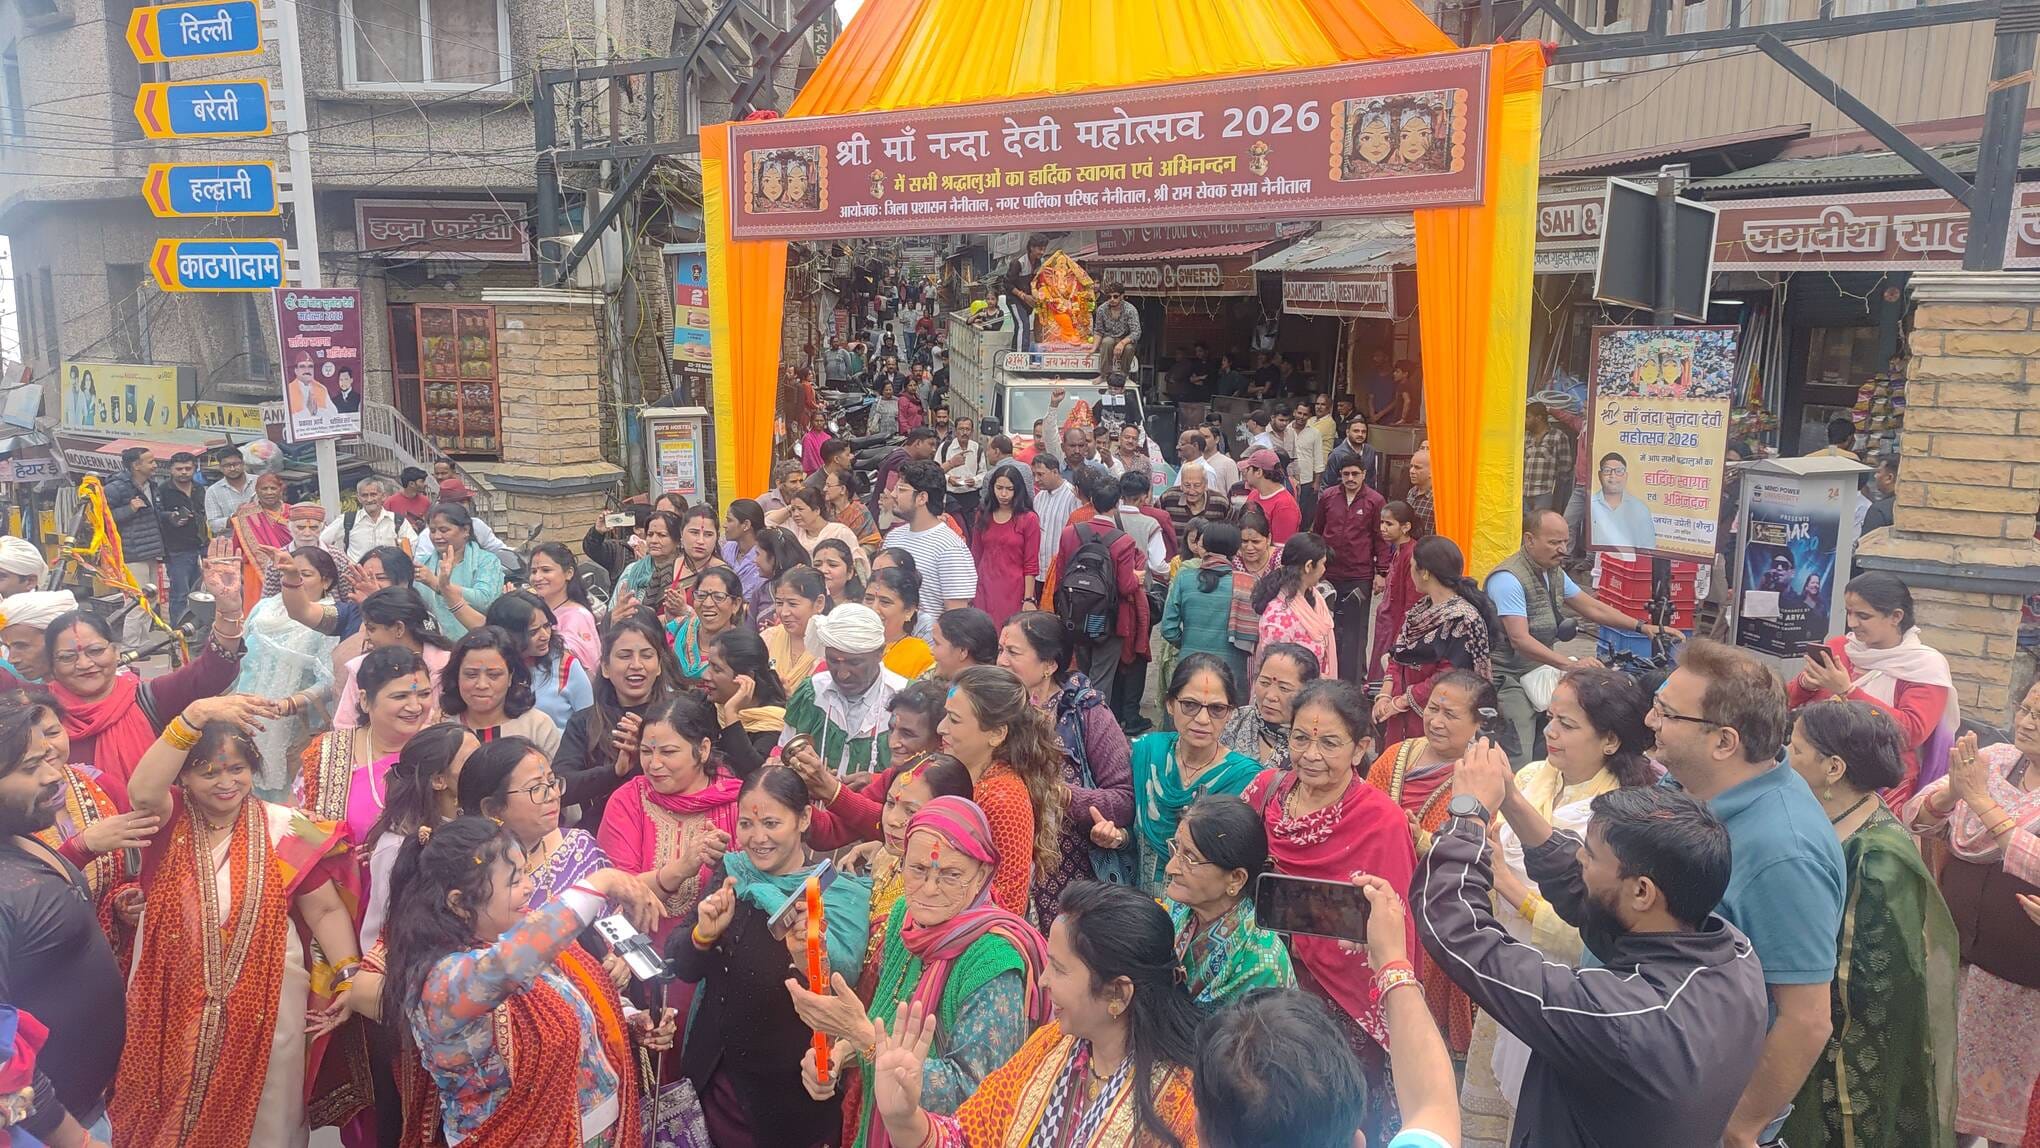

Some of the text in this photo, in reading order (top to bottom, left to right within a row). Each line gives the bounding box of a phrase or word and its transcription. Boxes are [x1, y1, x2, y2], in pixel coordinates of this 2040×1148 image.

[180, 8, 233, 45] दिल्ली
[192, 89, 239, 122] बरेली
[835, 100, 1320, 166] श्री माँ नन्दा देवी महोत्सव 2026
[189, 168, 252, 202] हल्द्वानी
[893, 173, 905, 193] में
[908, 171, 938, 192] सभी
[1005, 170, 1024, 186] का
[1028, 163, 1072, 185] हार्दिक
[1076, 163, 1127, 182] स्वागत
[1131, 156, 1153, 179] एवं
[1158, 153, 1237, 176] अभिनन्दन
[885, 200, 908, 216] जिला
[911, 200, 947, 215] प्रशासन
[950, 195, 993, 213] नैनीताल,
[996, 197, 1020, 211] नगर
[1022, 192, 1061, 209] पालिका
[1102, 186, 1150, 205] नैनीताल,
[1154, 183, 1169, 202] श्री
[1172, 186, 1192, 200] राम
[1196, 181, 1227, 199] सेवक
[1231, 182, 1257, 197] सभा
[1262, 176, 1311, 195] नैनीताल
[368, 218, 426, 241] इन्द्रा
[1541, 205, 1599, 235] SAH &
[1744, 206, 1885, 252] जगदीश
[179, 246, 279, 281] काठगोदाम
[1135, 270, 1158, 286] FOOD
[1178, 268, 1218, 285] SWEETS
[1701, 410, 1722, 427] देवी
[1620, 428, 1698, 447] महोत्सव 2026
[66, 452, 104, 471] MODERN
[1785, 613, 1806, 621] ARYA
